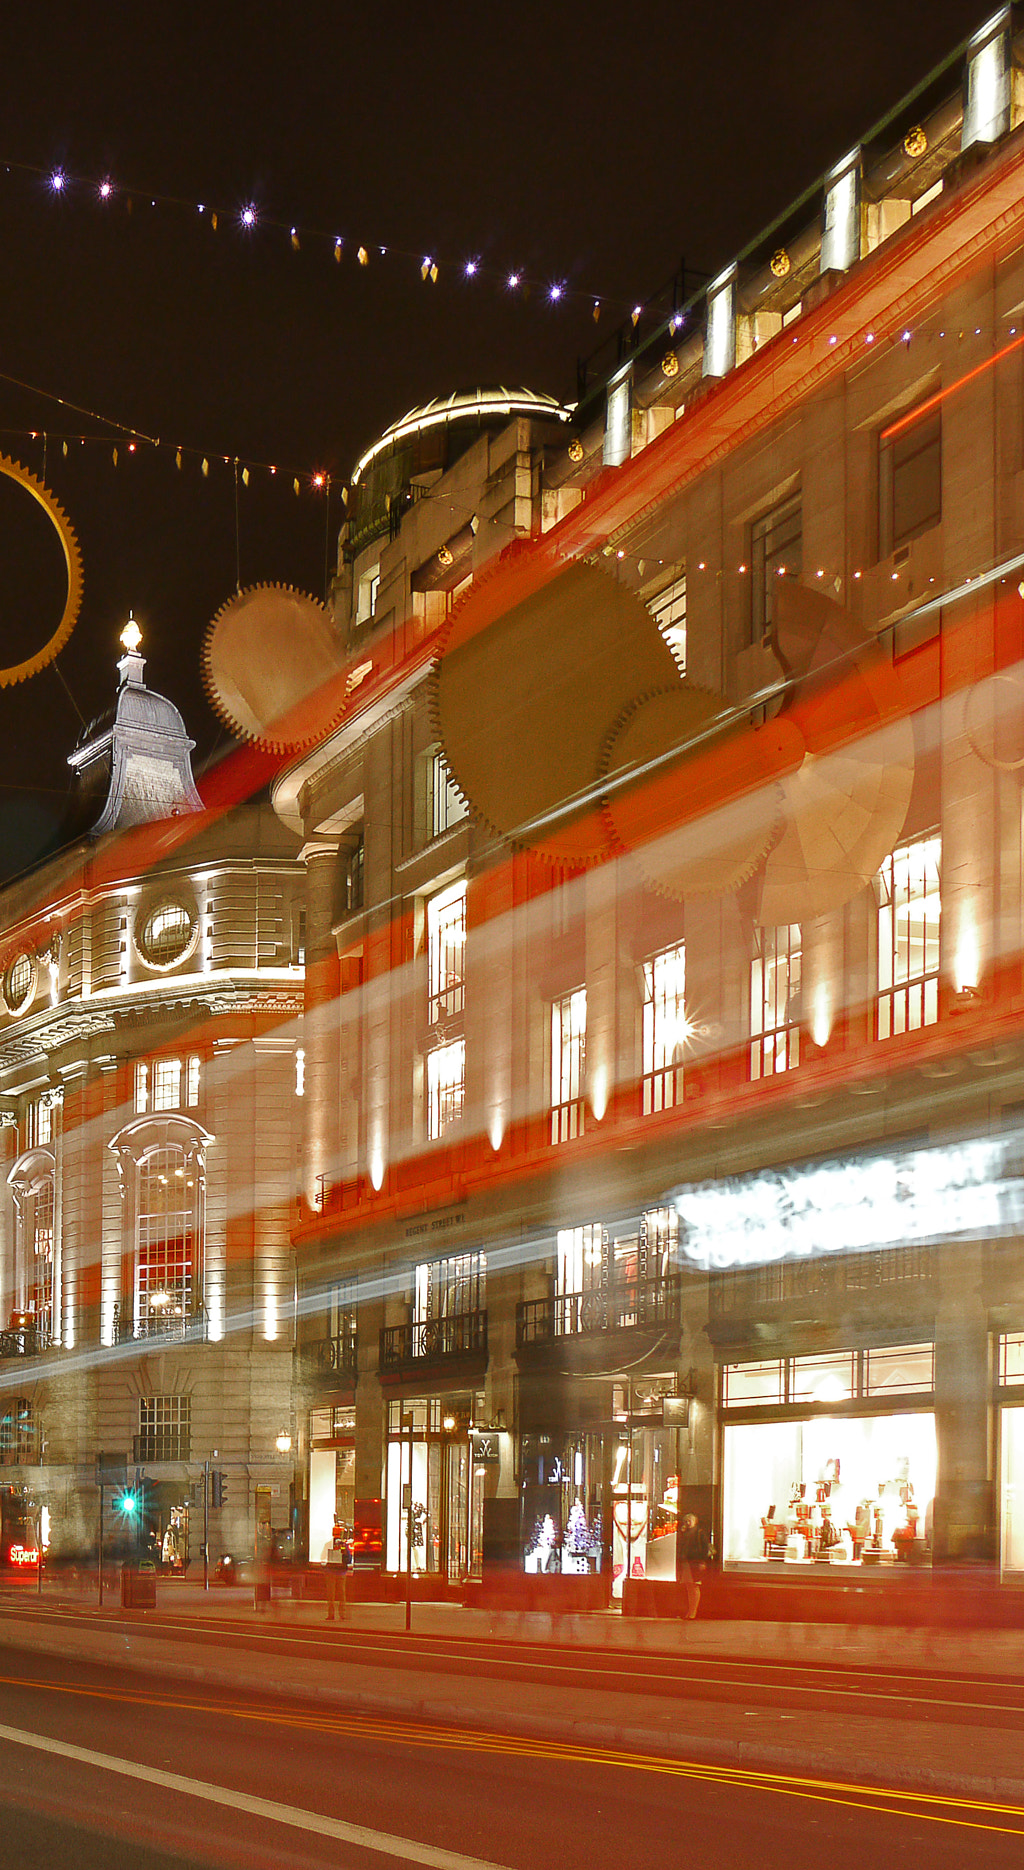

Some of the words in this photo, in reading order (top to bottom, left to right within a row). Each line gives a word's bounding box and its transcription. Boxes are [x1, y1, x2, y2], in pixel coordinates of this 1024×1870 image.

[405, 1223, 428, 1237] REGENT
[431, 1216, 454, 1230] STREET
[10, 1547, 39, 1565] Superdr
